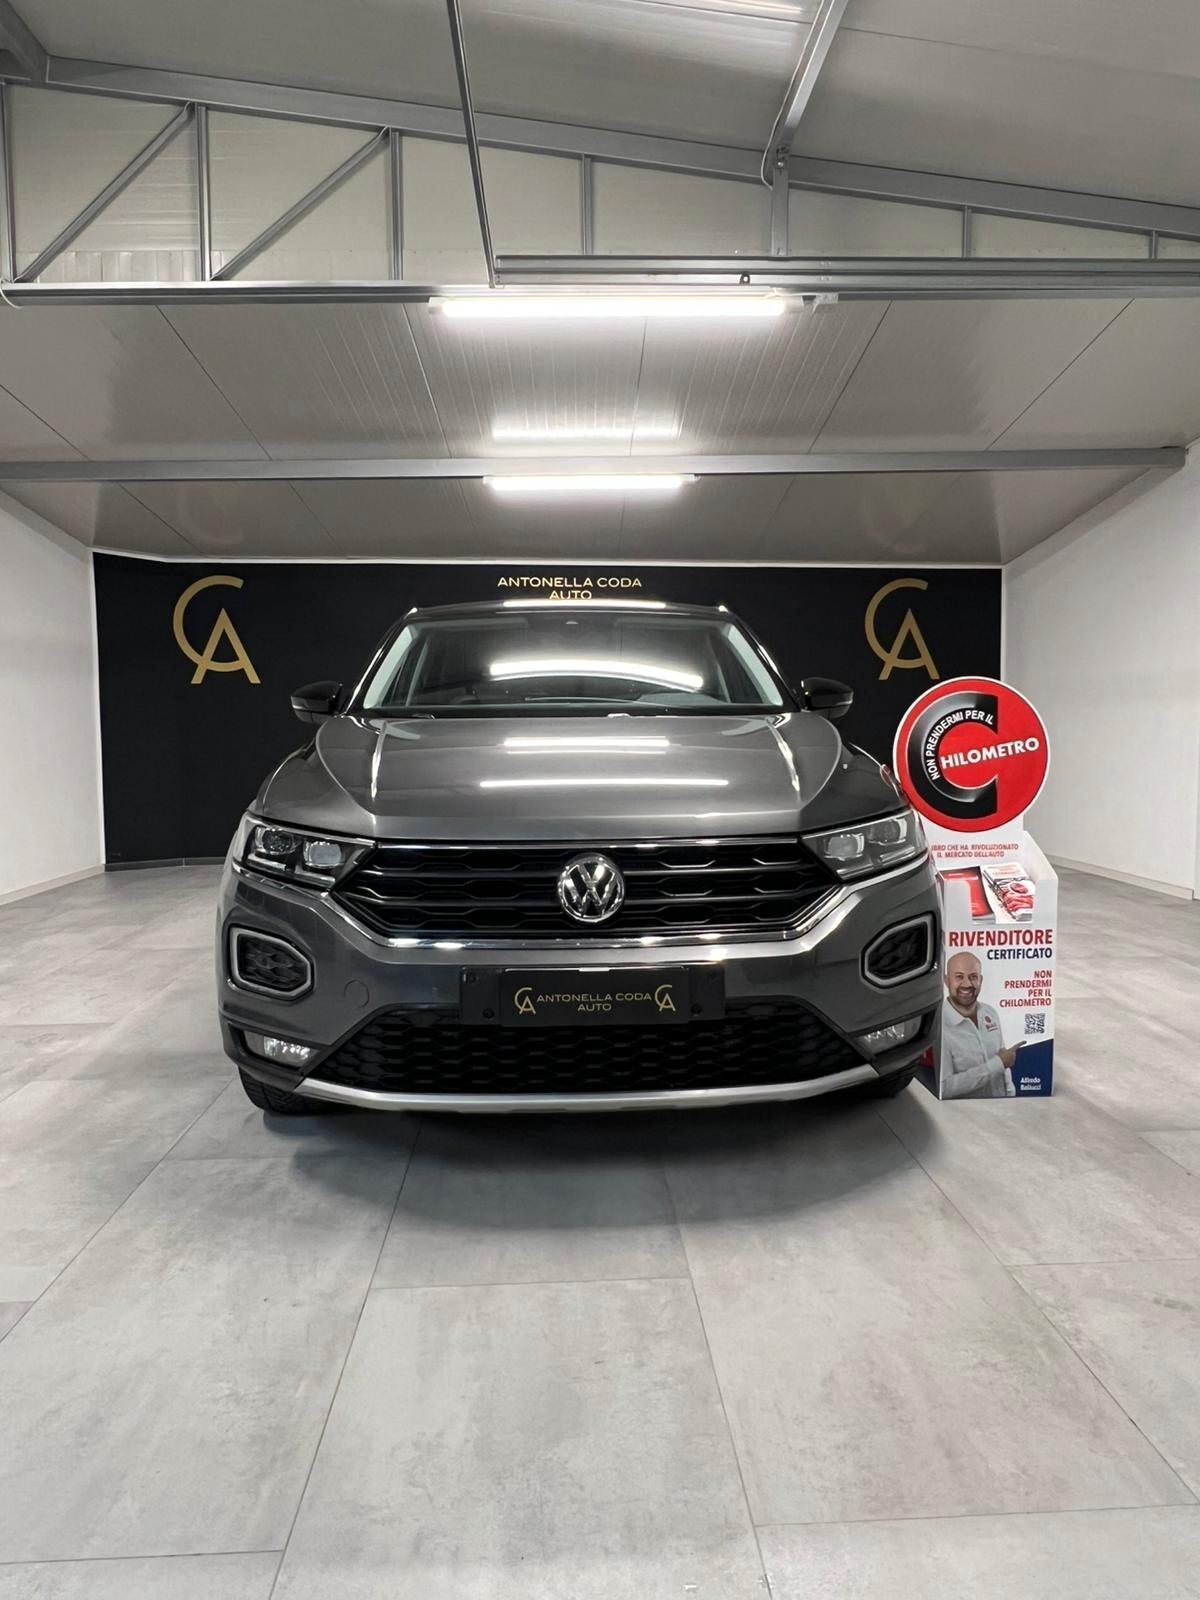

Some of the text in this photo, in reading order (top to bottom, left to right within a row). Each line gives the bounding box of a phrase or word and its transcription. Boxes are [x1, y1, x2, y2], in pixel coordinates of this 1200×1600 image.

[497, 577, 642, 588] ANTONELLA CODA
[549, 590, 592, 600] AUTO
[926, 710, 994, 780] NON PRENDERMI PER IL
[940, 738, 1040, 770] HILOMETRO
[948, 929, 1053, 947] RIVENDITORE
[986, 948, 1053, 960] CERTIFICATO
[1034, 970, 1052, 979] NON
[1004, 979, 1052, 989] PRENDERMI
[536, 992, 652, 1002] ANTONELLA CODA
[1028, 988, 1052, 998] PER IL
[577, 1003, 612, 1012] AUTO
[999, 997, 1052, 1008] CHILOMETRO
